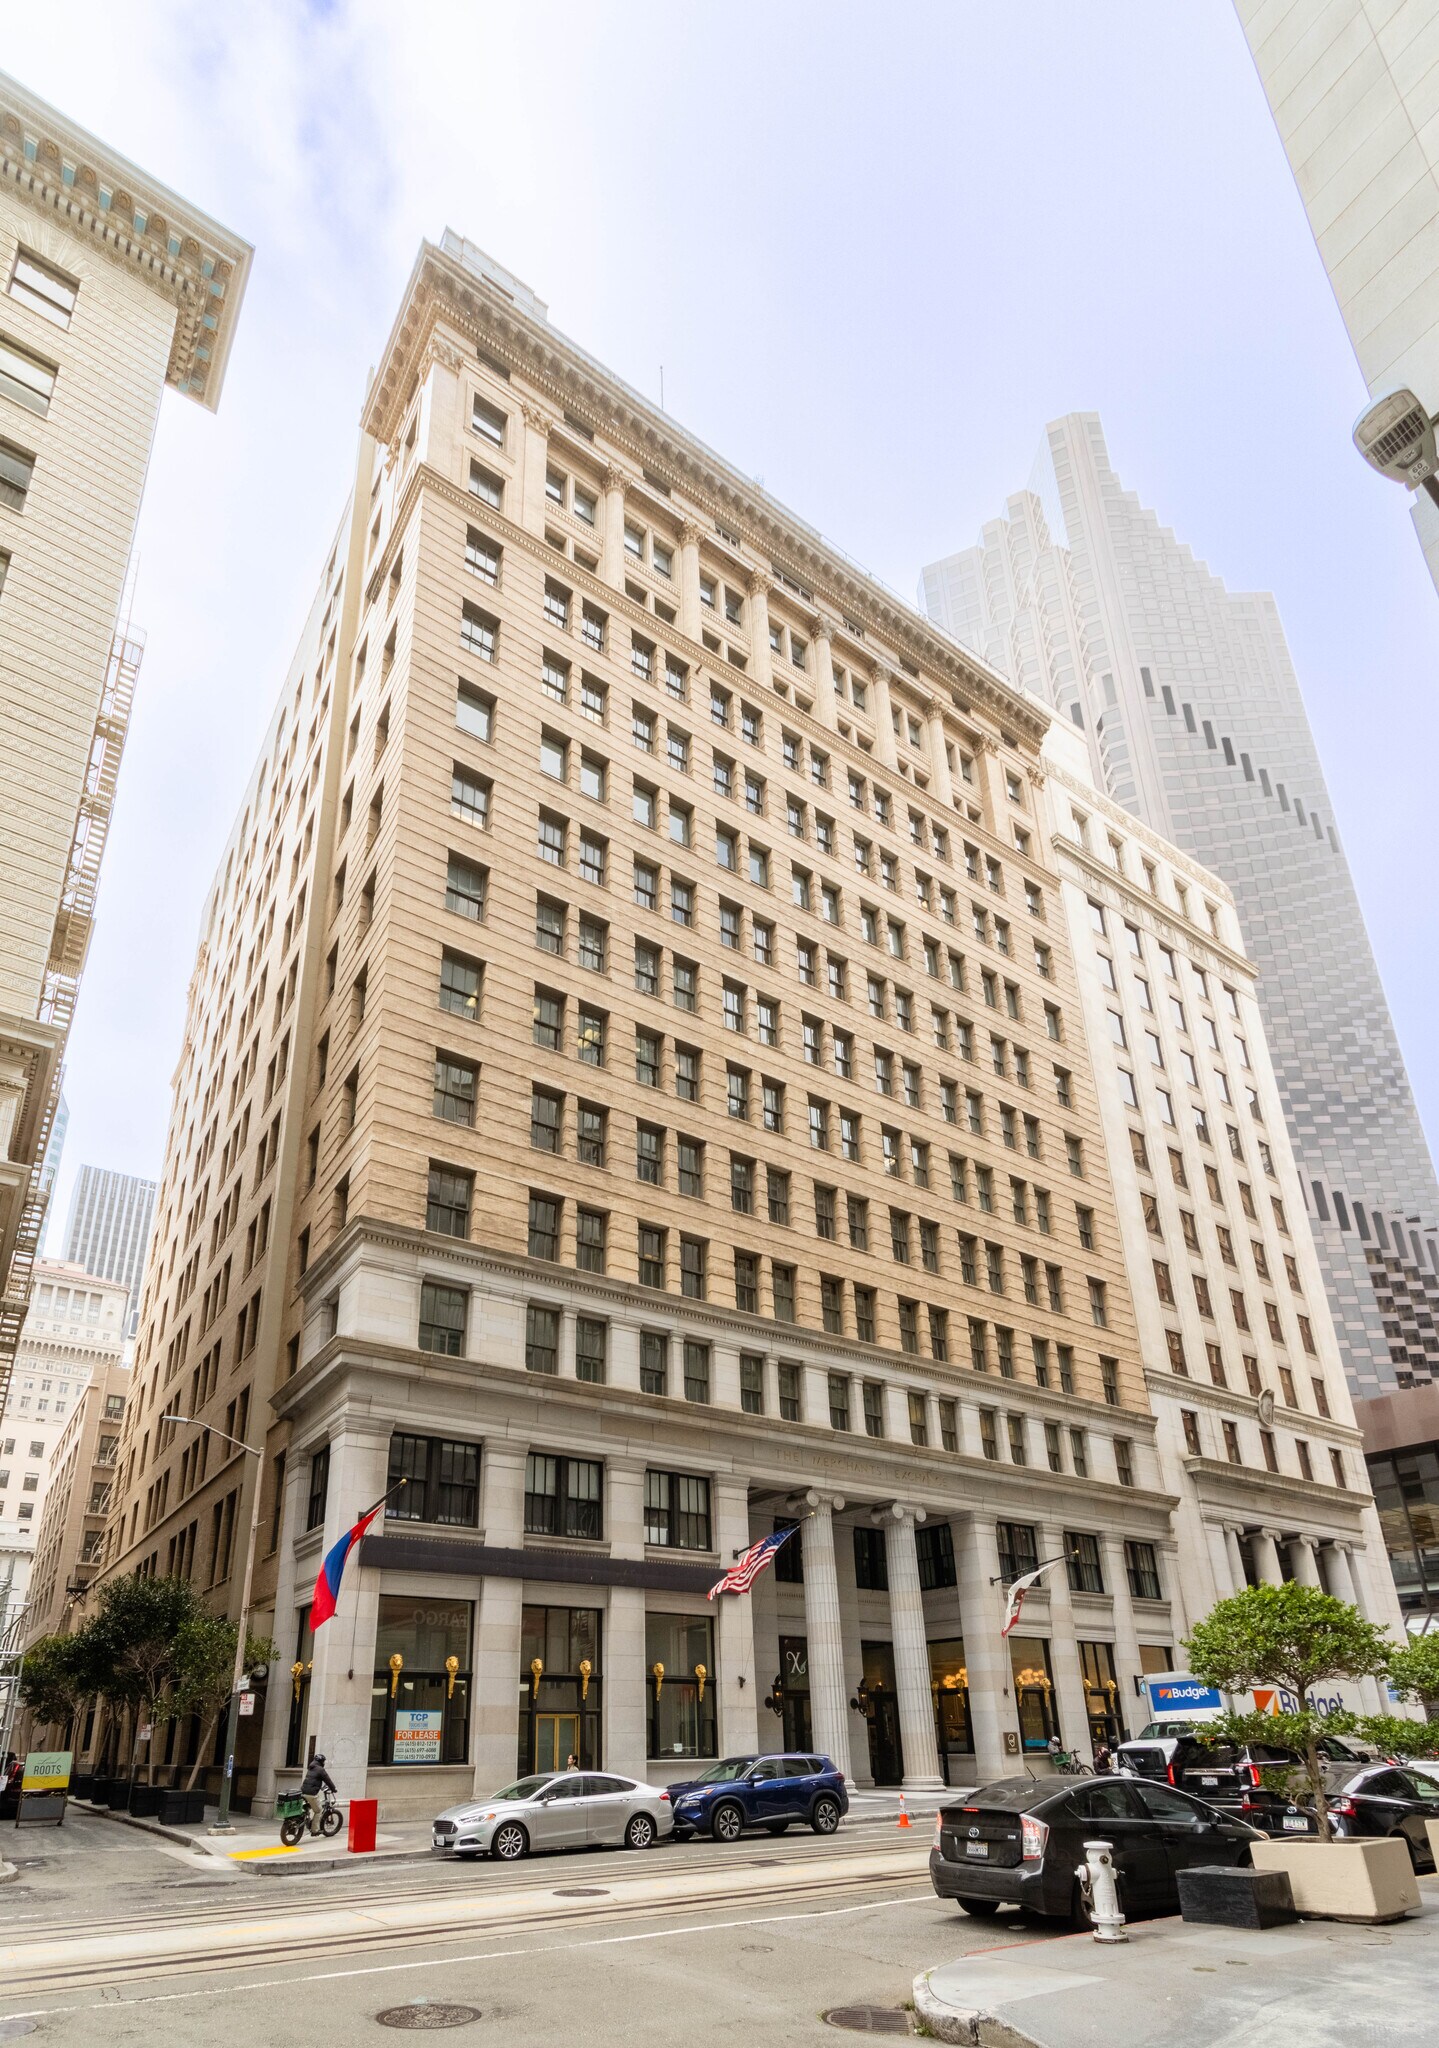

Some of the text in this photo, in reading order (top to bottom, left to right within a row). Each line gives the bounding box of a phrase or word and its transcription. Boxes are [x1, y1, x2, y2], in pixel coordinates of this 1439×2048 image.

[1412, 462, 1423, 473] 60
[1413, 466, 1429, 480] LED
[774, 1448, 799, 1463] THE
[811, 1455, 882, 1477] MERCHANTS
[1171, 1686, 1210, 1700] Budget
[410, 1713, 429, 1721] TCP
[397, 1731, 439, 1739] FOR LEASE
[33, 1765, 62, 1775] ROOTS
